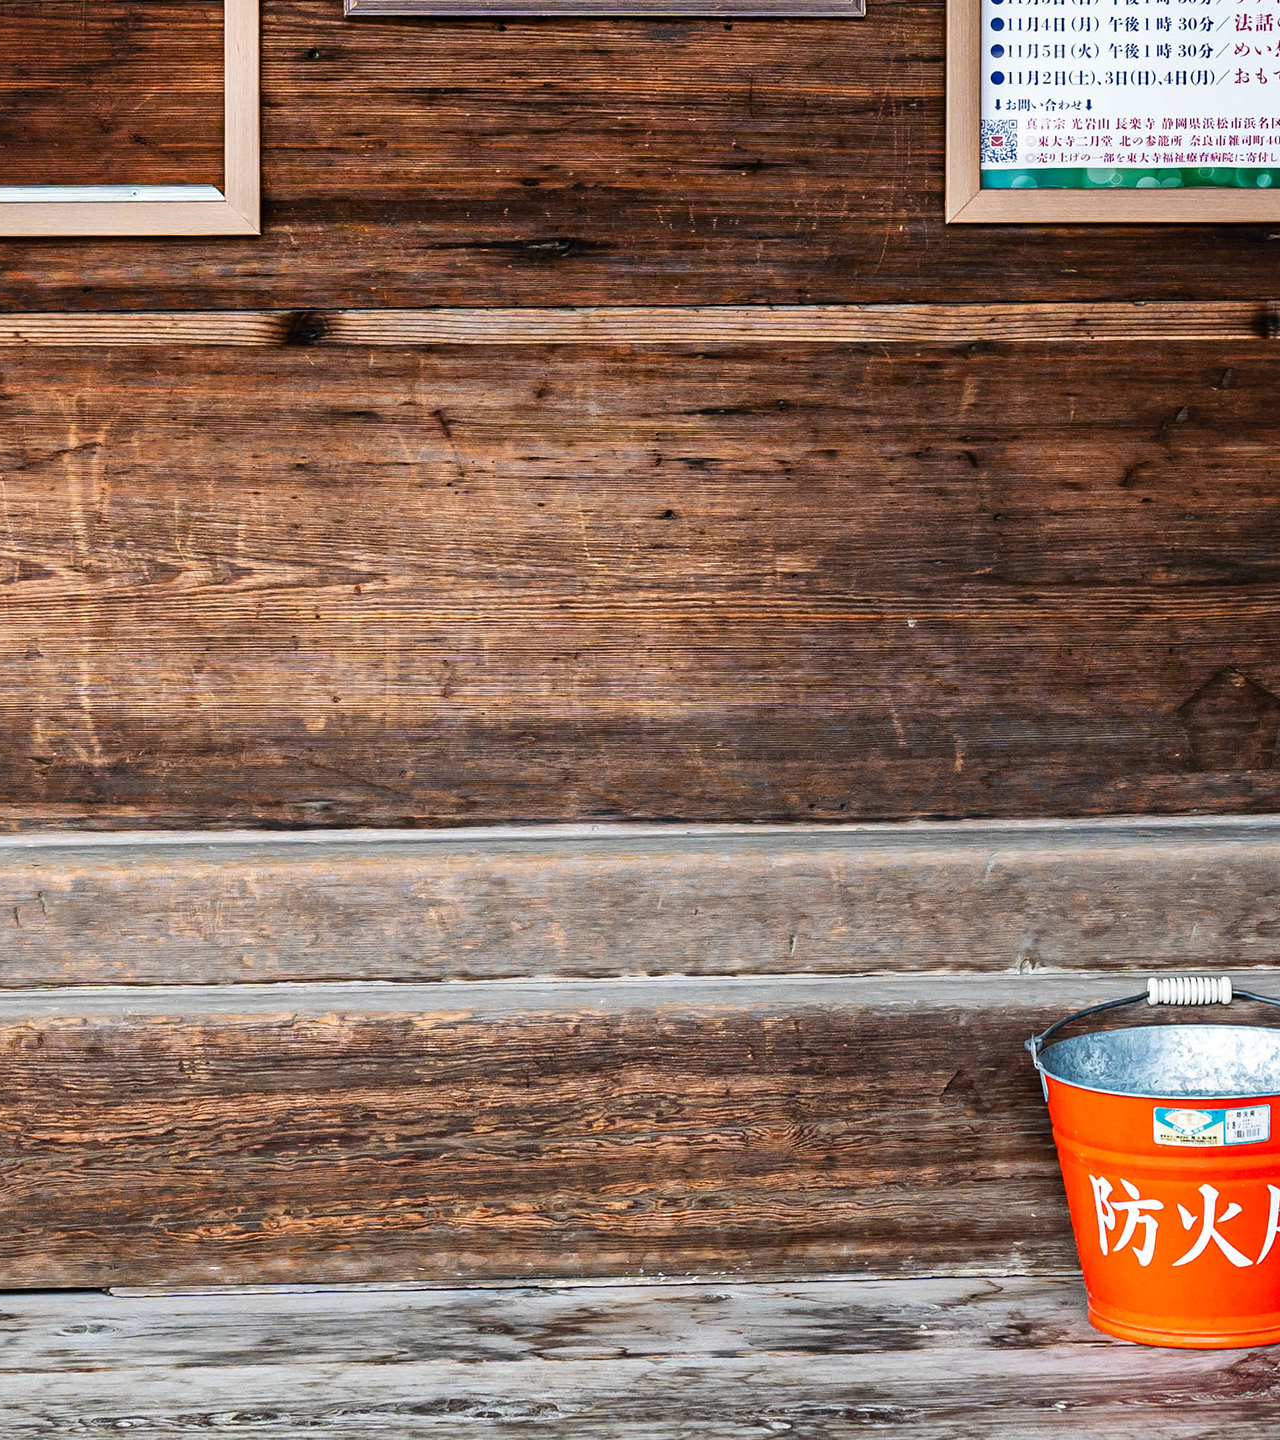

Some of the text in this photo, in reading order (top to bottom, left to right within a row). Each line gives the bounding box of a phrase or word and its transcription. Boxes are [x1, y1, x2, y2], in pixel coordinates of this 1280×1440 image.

[1005, 98, 1083, 111] お問い合わせ
[1025, 117, 1066, 131] 真言宗
[1071, 117, 1110, 130] 光岩山
[1115, 117, 1156, 130] 長楽寺
[1038, 135, 1113, 148] 東大寺二月堂
